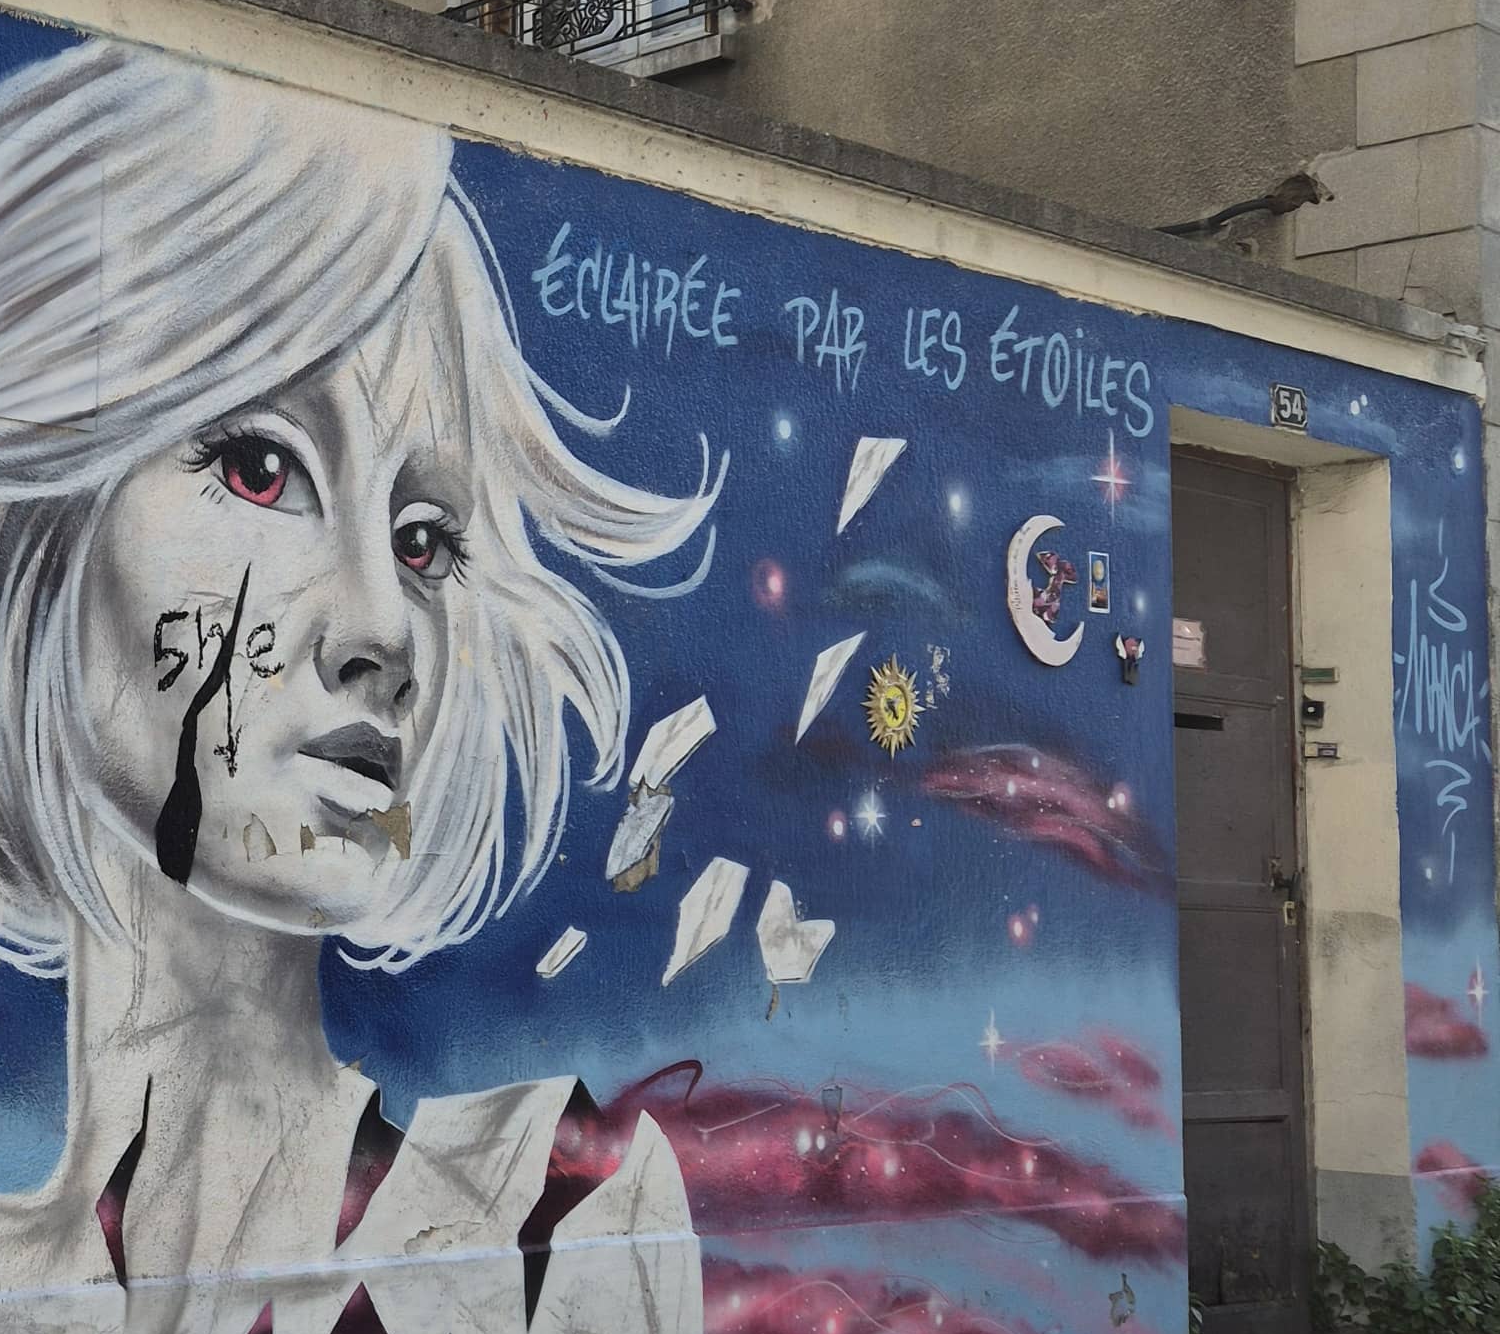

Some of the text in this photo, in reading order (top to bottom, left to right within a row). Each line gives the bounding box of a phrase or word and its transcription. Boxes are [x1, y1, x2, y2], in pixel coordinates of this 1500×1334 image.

[784, 289, 867, 393] PAR
[903, 306, 967, 391] LES
[1279, 390, 1304, 422] 54
